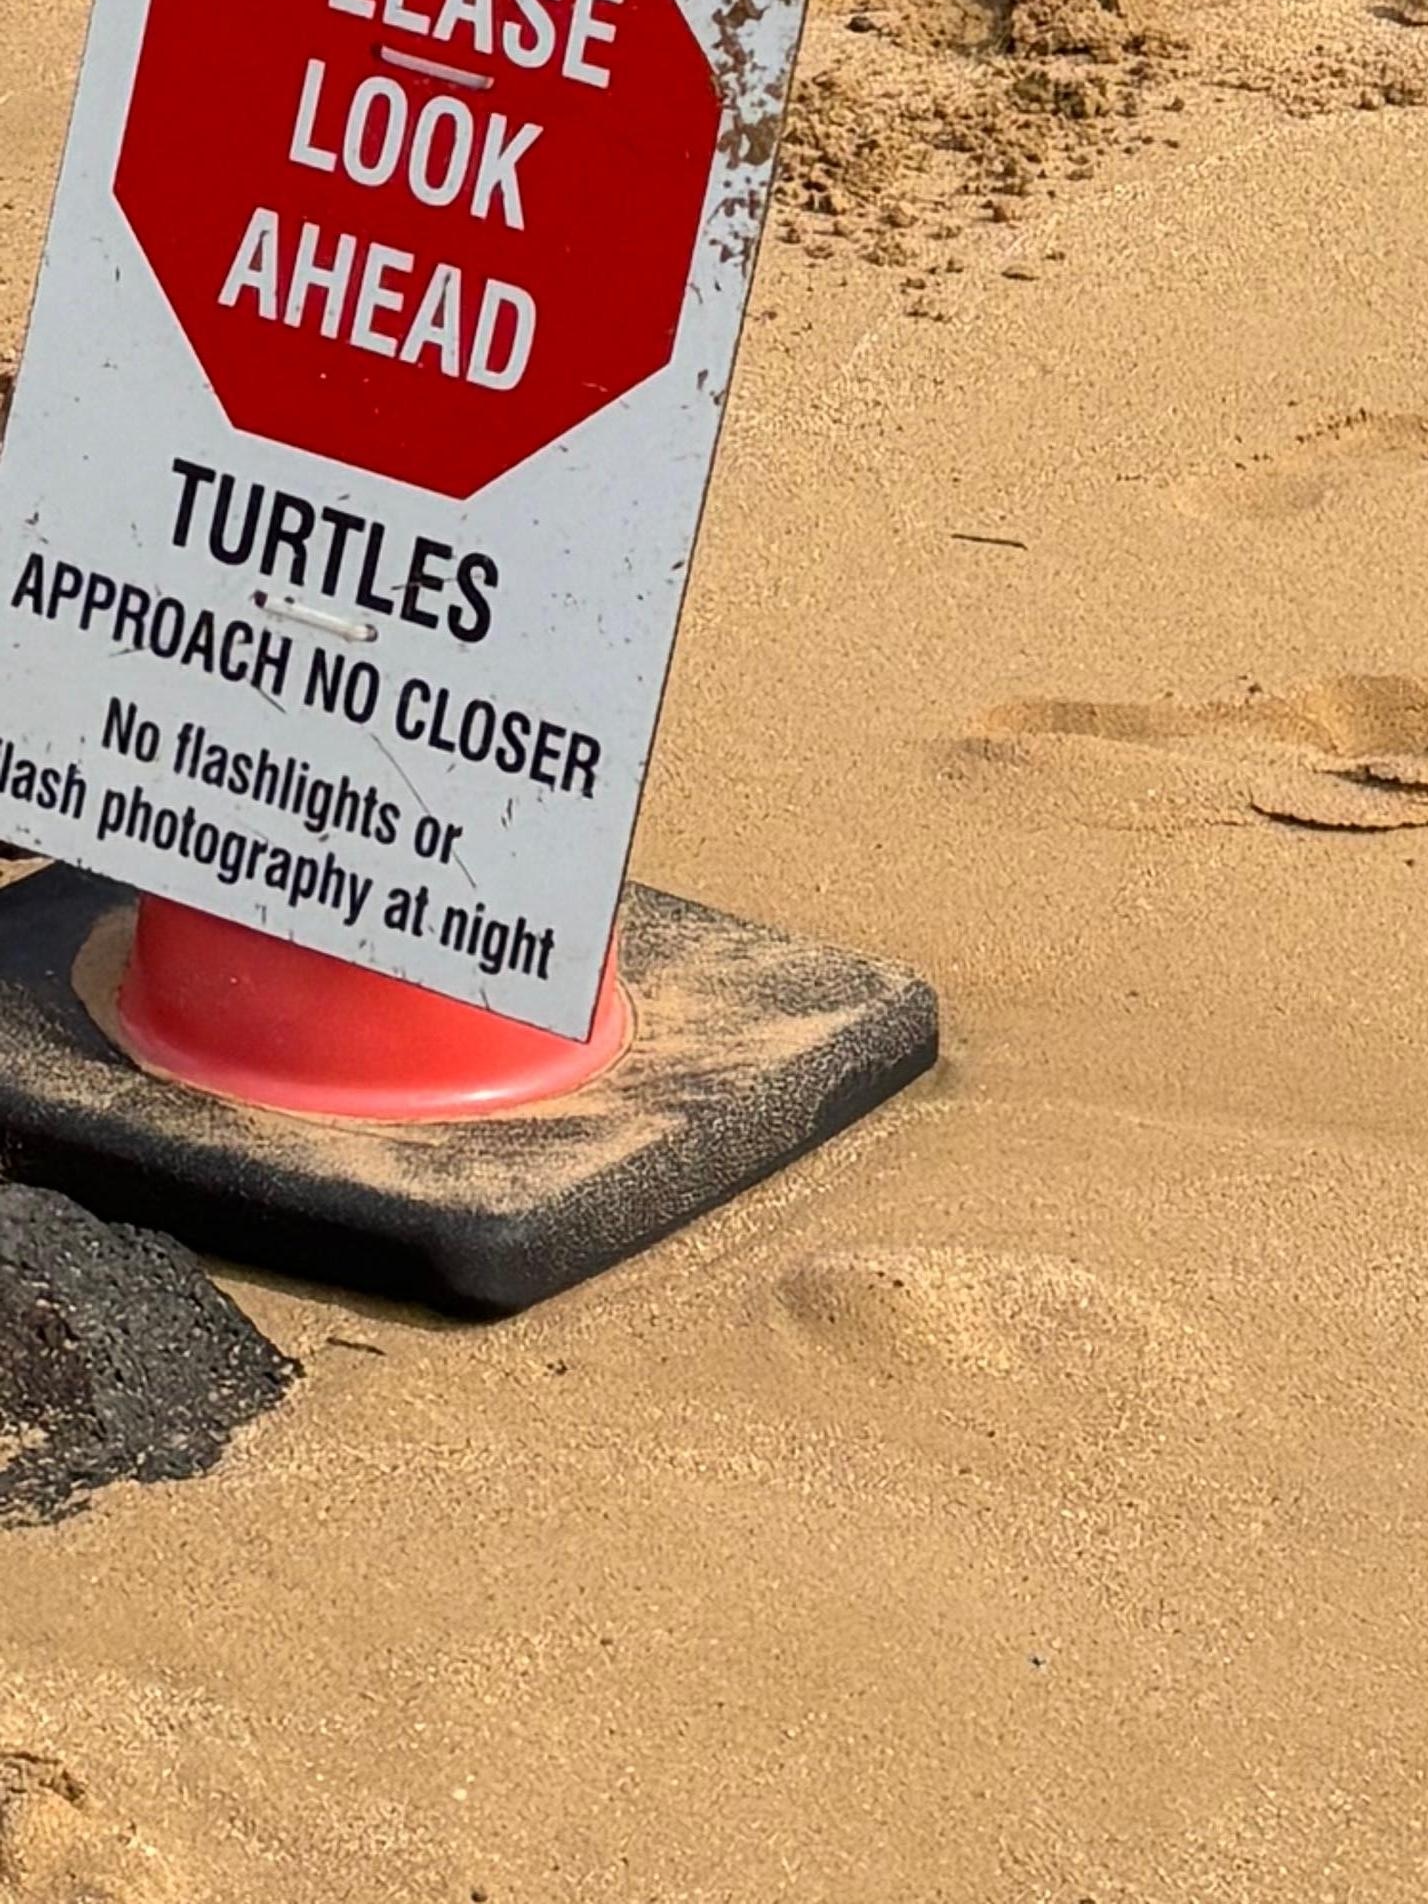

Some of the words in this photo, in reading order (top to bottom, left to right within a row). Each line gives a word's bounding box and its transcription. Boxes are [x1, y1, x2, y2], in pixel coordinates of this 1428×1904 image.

[289, 58, 544, 230] LOOK
[218, 207, 536, 390] AHEAD
[172, 457, 499, 644] TURTLES
[10, 552, 293, 696] APPROACH
[303, 646, 380, 725] NO
[395, 678, 601, 799] CLOSER
[0, 737, 87, 820] lash
[96, 785, 374, 927] photography
[383, 884, 429, 938] at
[438, 902, 555, 981] night
[101, 696, 160, 763] No
[173, 722, 401, 846] flashlights
[414, 815, 463, 865] or
